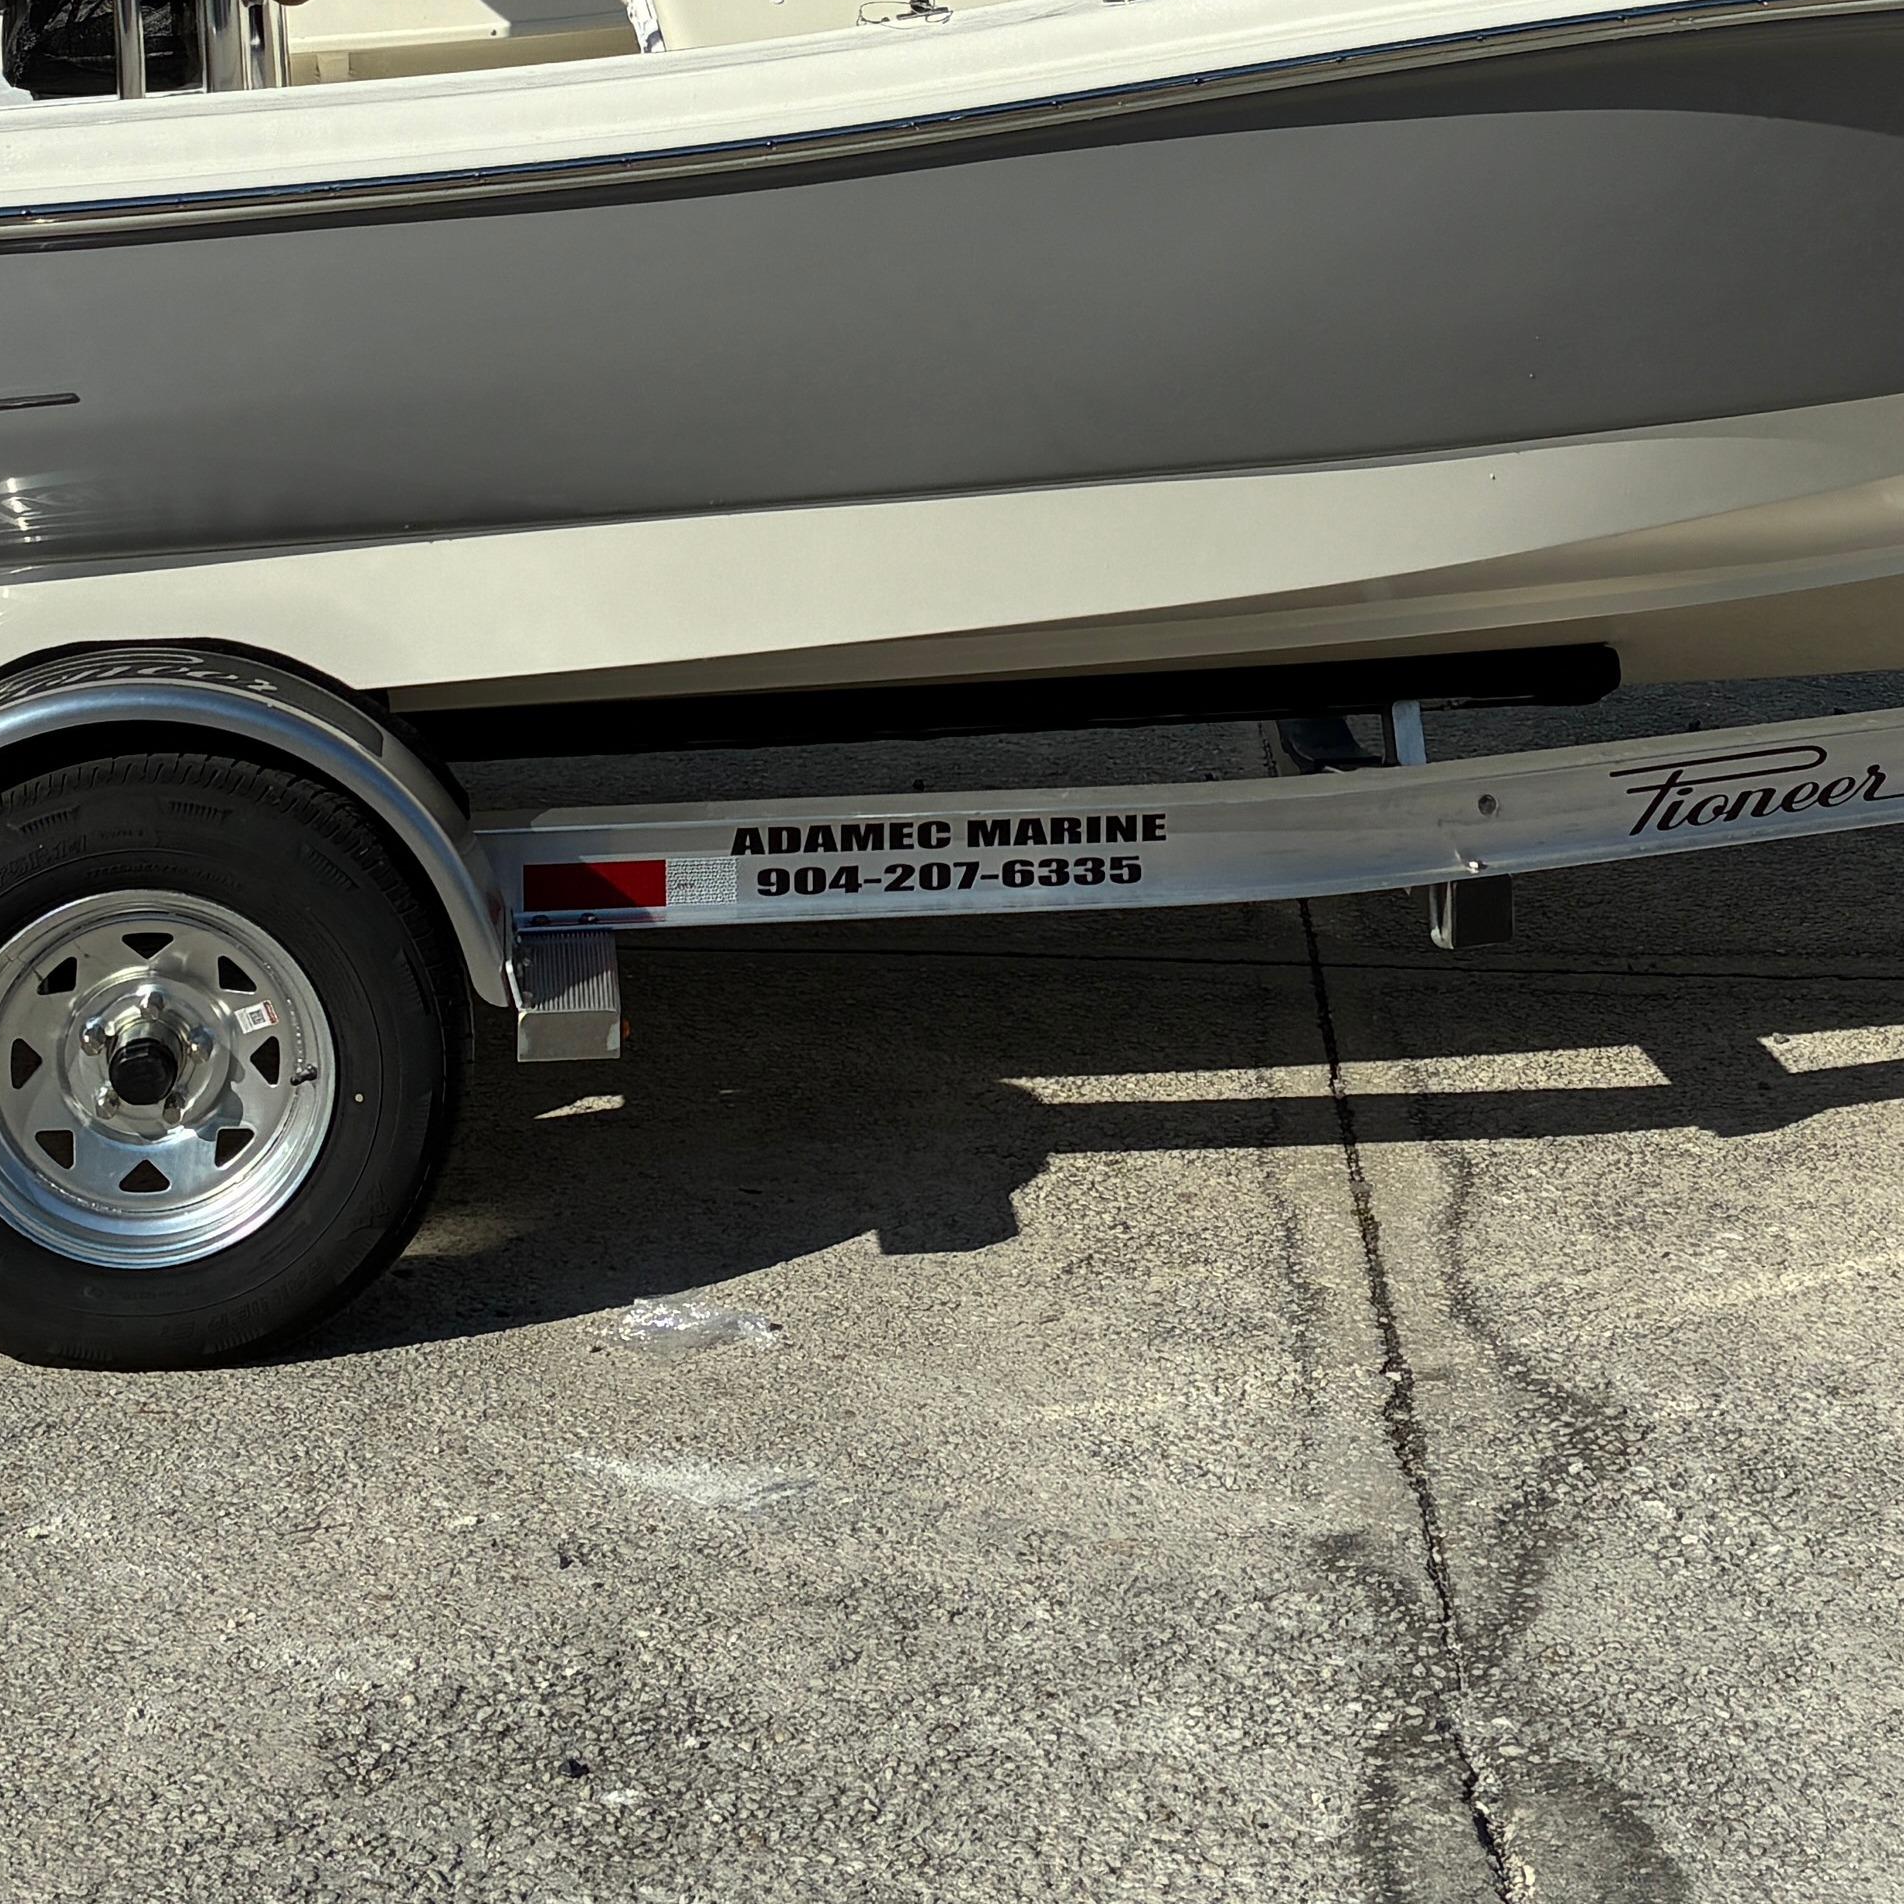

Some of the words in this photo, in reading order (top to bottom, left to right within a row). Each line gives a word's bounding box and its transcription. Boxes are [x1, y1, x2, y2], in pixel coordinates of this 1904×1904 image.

[730, 820, 952, 857] ADAMEC
[966, 813, 1168, 848] MARINE
[756, 855, 1143, 897] 904-207-6335
